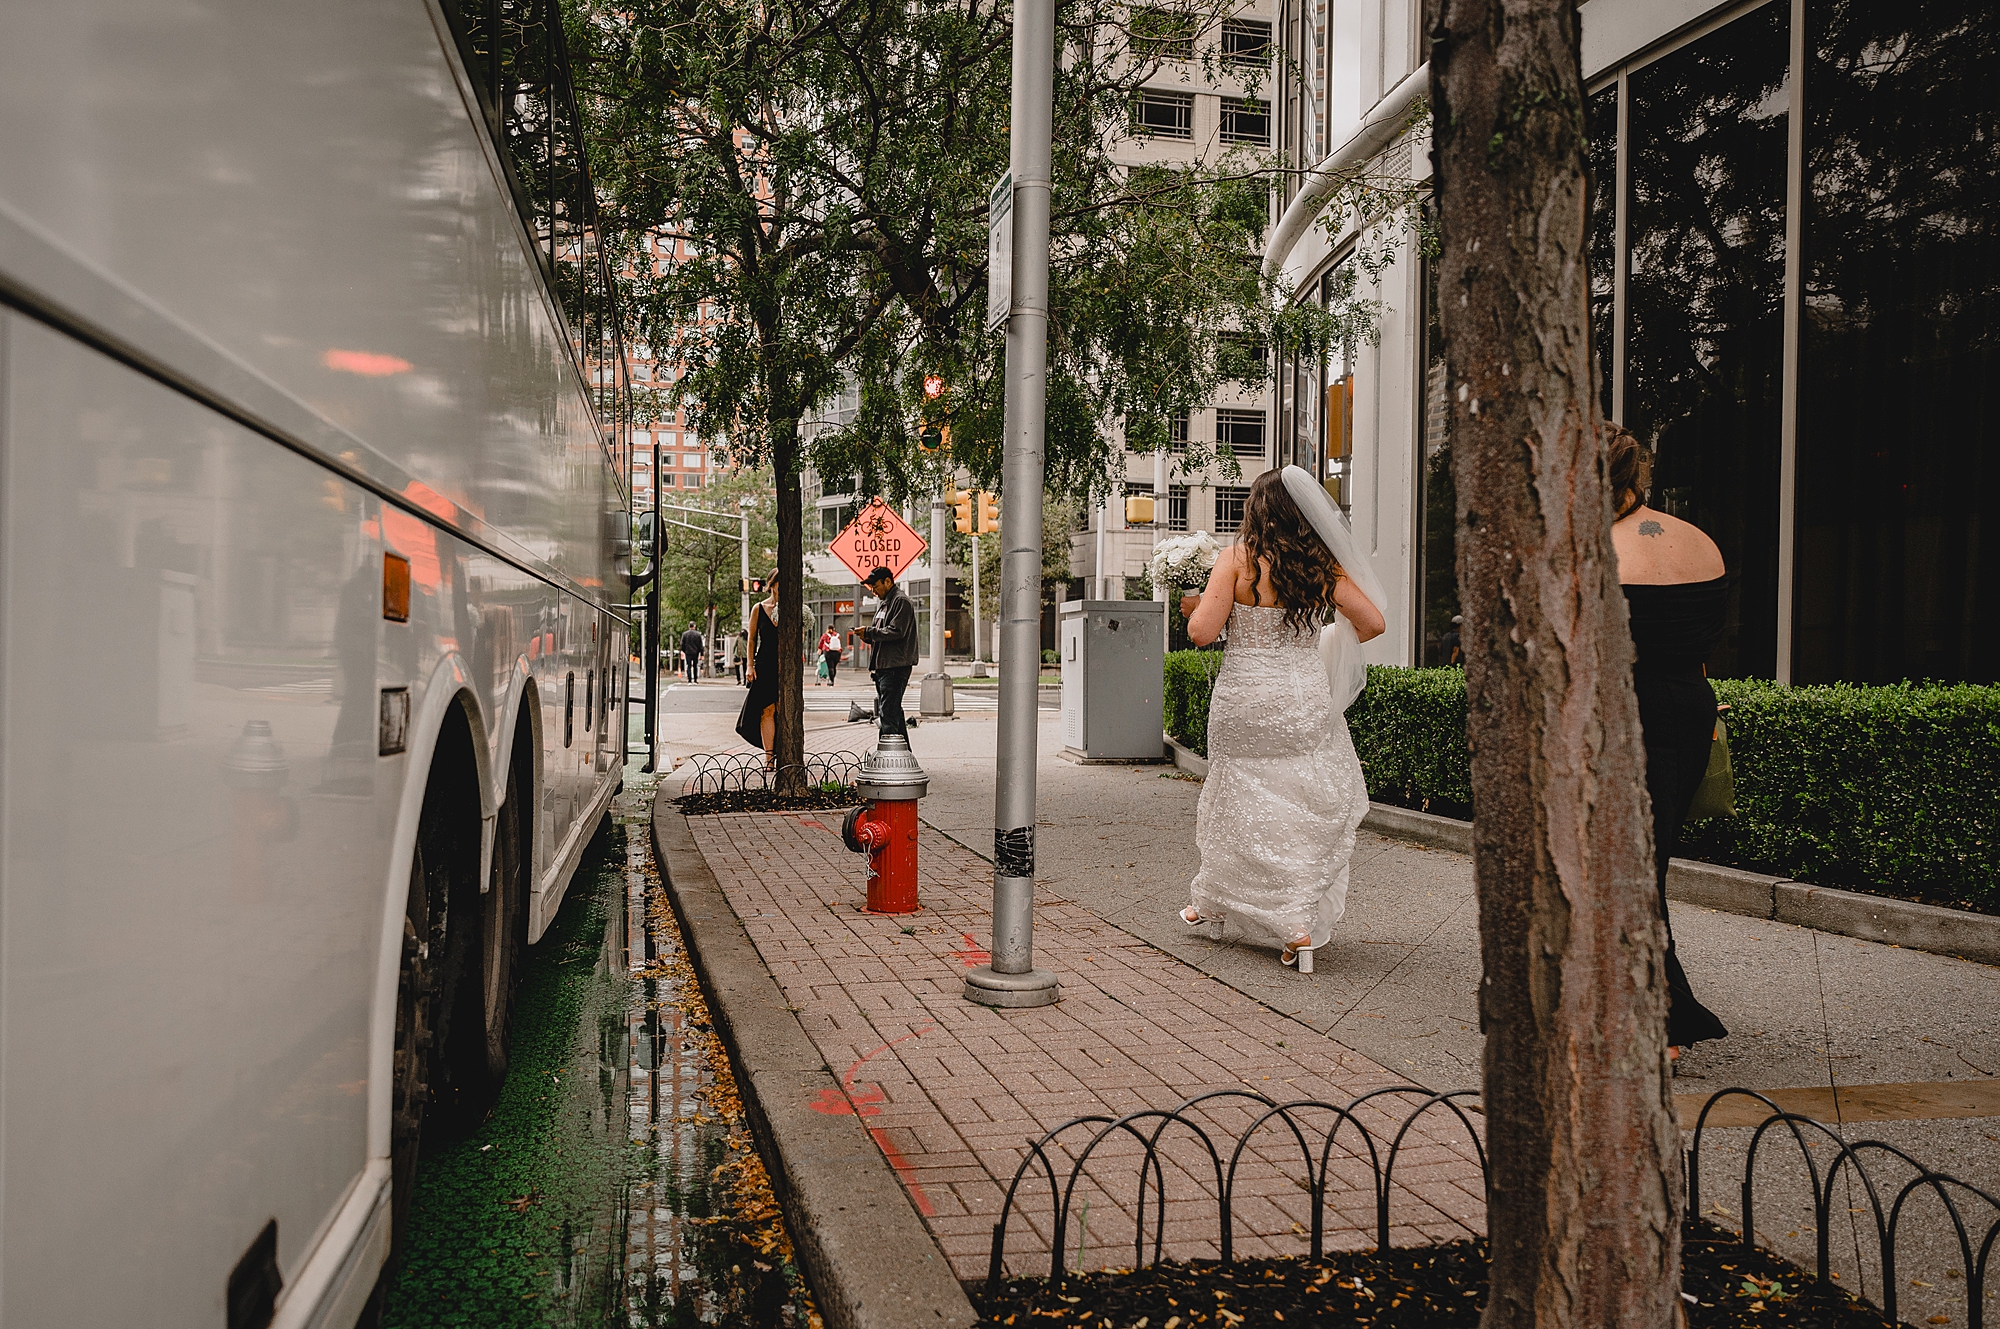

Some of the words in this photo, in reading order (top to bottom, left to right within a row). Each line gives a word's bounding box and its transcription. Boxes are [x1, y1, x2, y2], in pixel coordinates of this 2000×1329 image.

[854, 539, 901, 552] CLOSED
[856, 554, 880, 567] 750
[885, 554, 899, 566] FT
